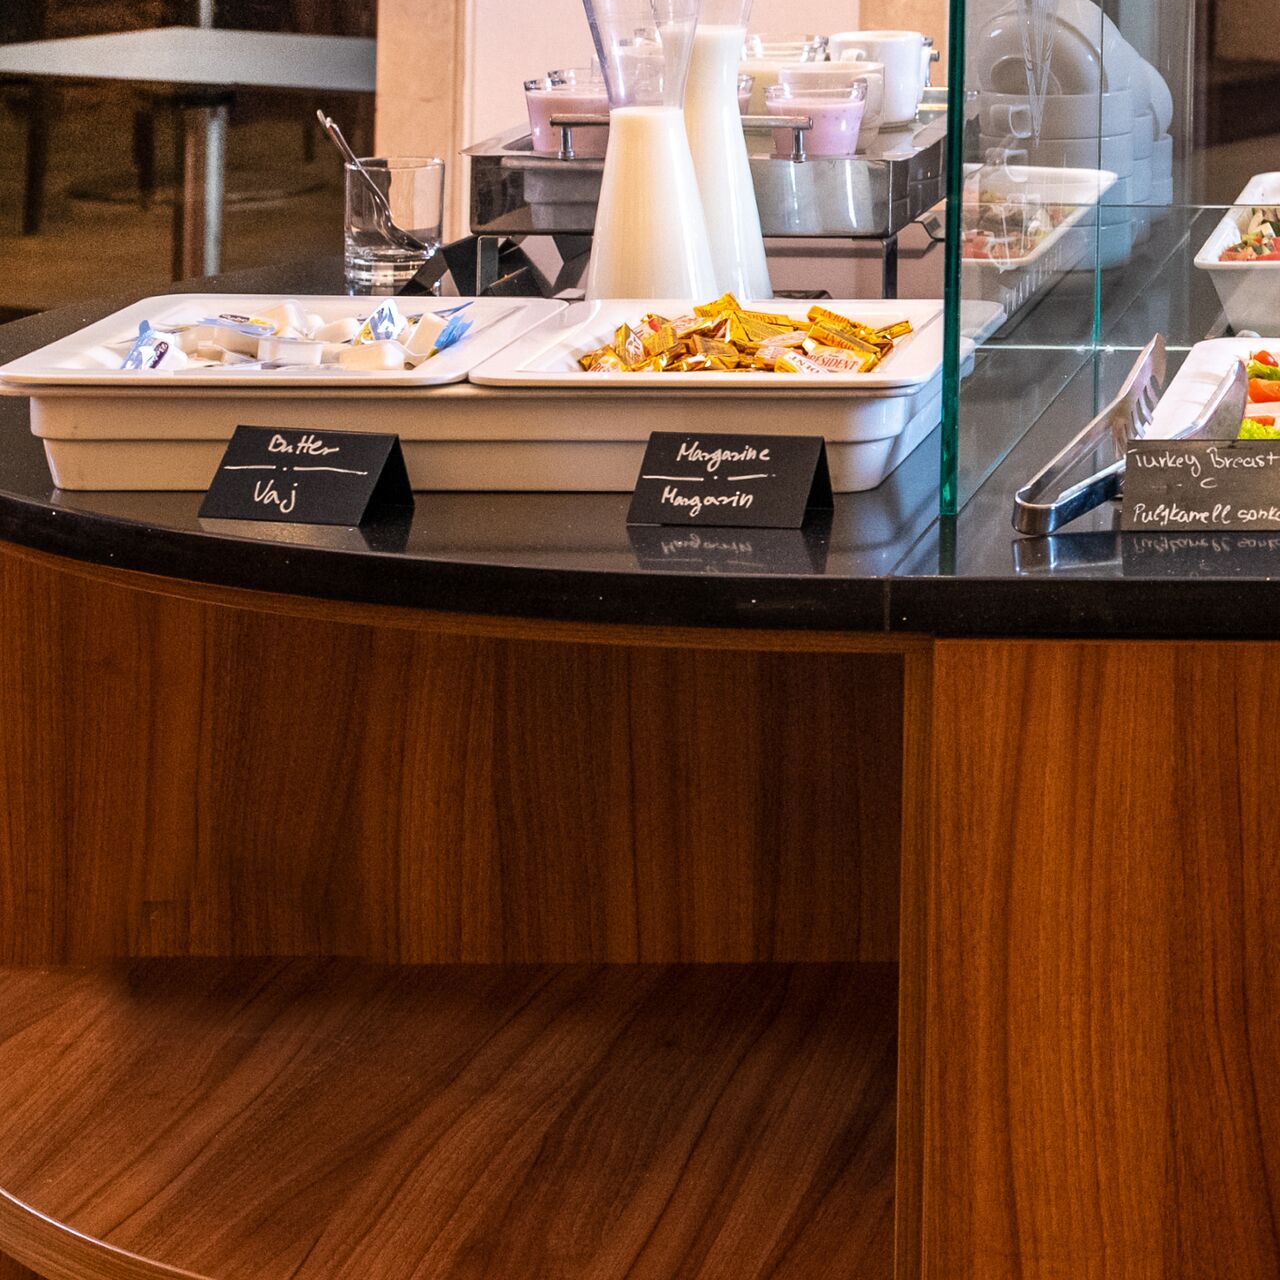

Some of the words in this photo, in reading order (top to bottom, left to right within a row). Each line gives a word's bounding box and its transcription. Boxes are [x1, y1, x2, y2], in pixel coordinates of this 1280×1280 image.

[268, 434, 340, 455] Butter
[676, 441, 771, 472] Margarine
[1128, 449, 1201, 477] Turkey
[1206, 447, 1280, 468] Breast
[254, 479, 299, 514] Vaj
[661, 485, 754, 517] Margarin
